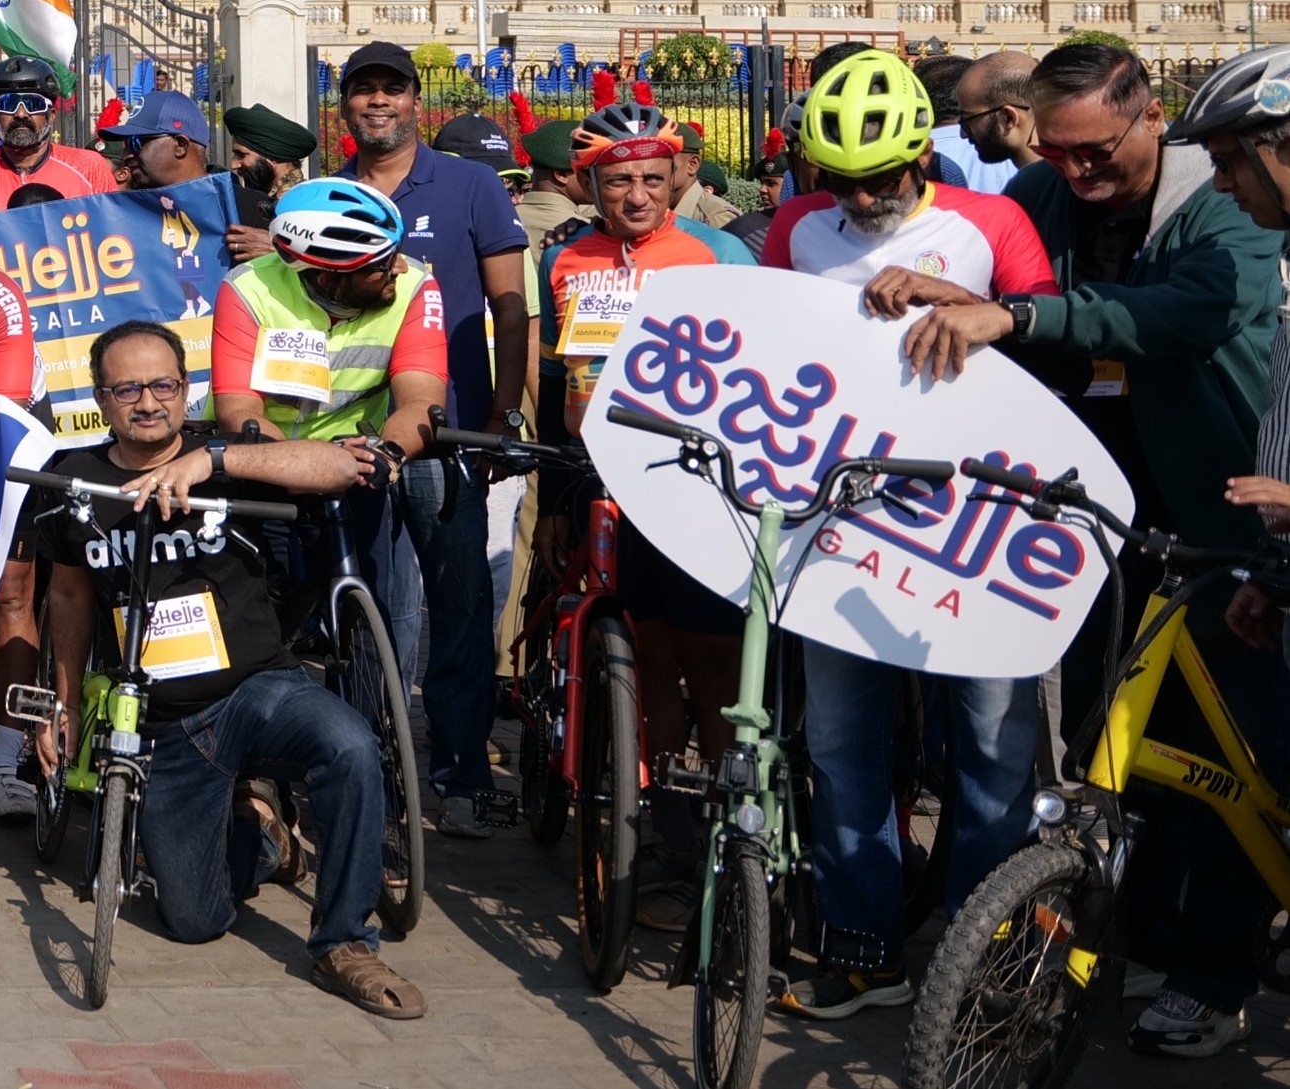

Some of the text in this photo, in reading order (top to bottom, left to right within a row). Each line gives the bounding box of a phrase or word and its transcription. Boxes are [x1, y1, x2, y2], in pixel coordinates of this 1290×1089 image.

[282, 220, 315, 242] KASK
[423, 290, 443, 331] BCC
[182, 335, 211, 352] Chall
[574, 327, 601, 337] Abhitek
[42, 358, 77, 374] orate
[815, 528, 963, 619] GALA
[160, 600, 205, 624] Hejje
[1182, 762, 1249, 803] SPORT
